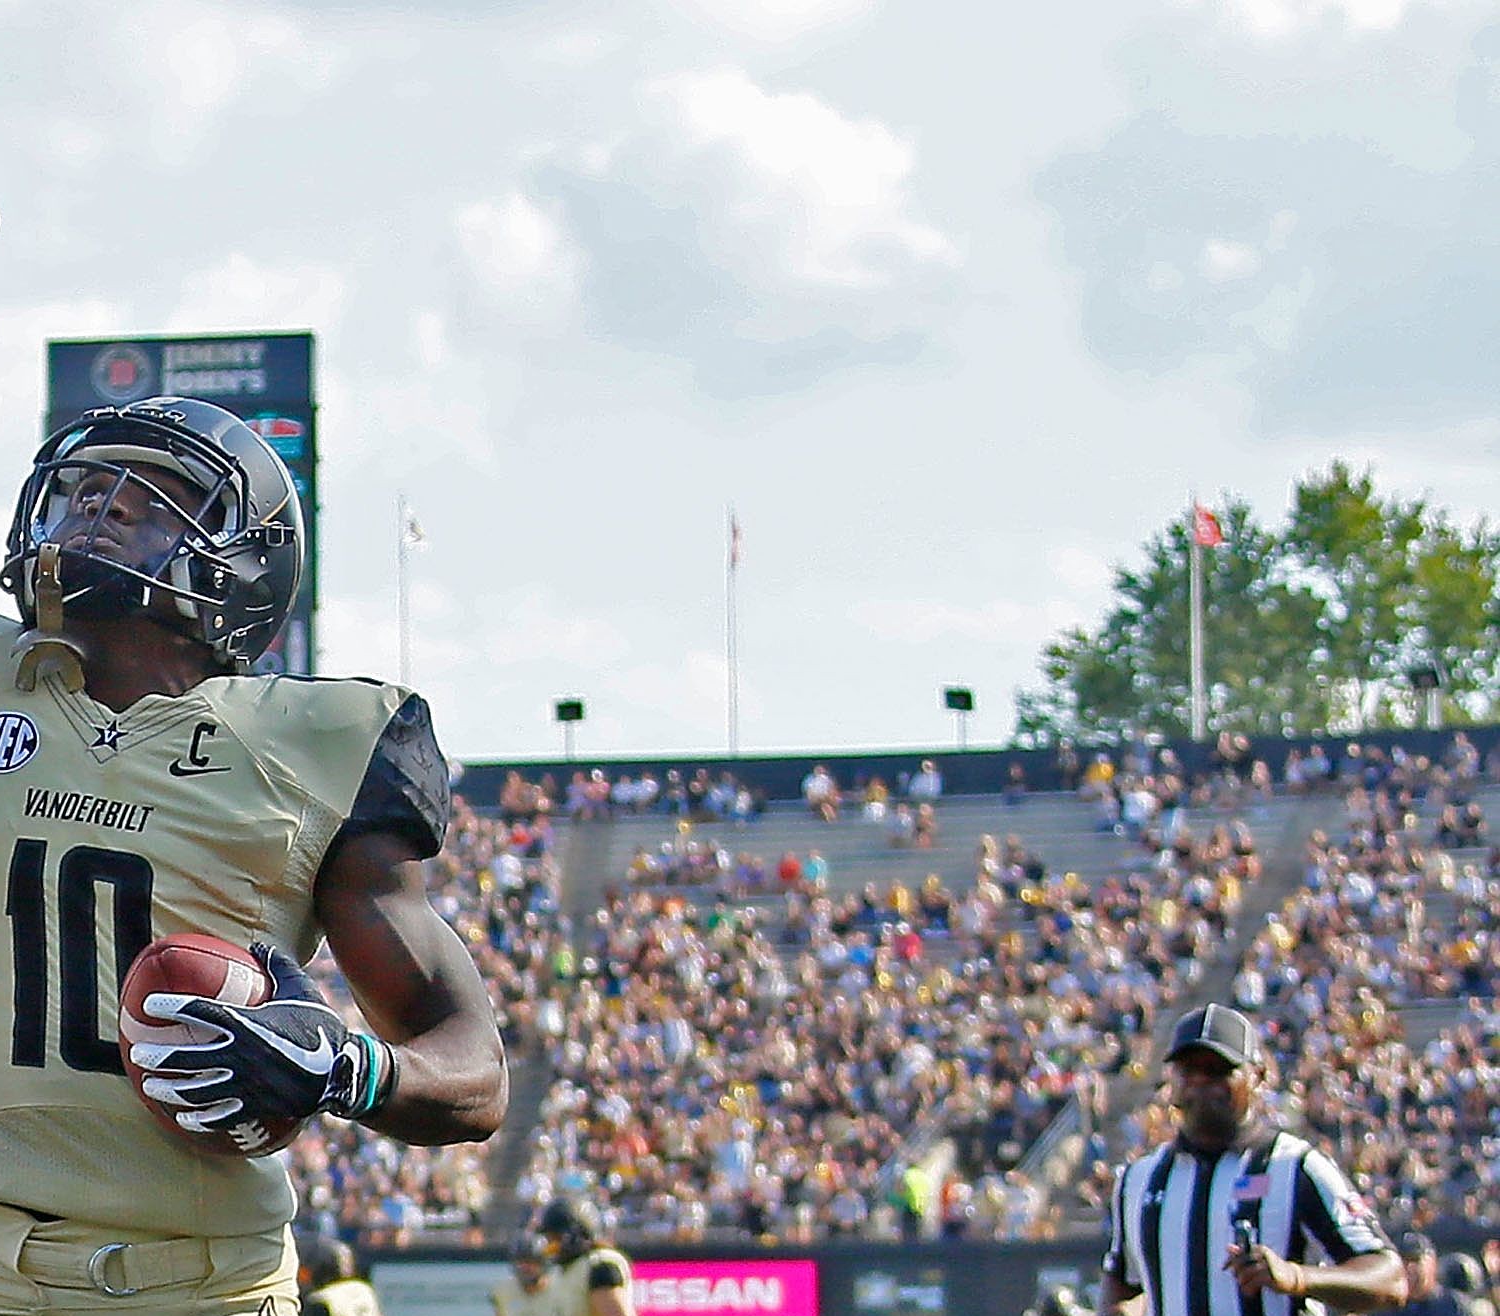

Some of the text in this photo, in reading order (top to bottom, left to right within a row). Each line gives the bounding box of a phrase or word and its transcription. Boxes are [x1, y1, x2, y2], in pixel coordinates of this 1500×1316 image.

[104, 730, 118, 743] V
[190, 722, 217, 767] C
[23, 787, 155, 833] VANDERBILT
[7, 837, 154, 1076] 10
[632, 1277, 782, 1310] ISSAN
